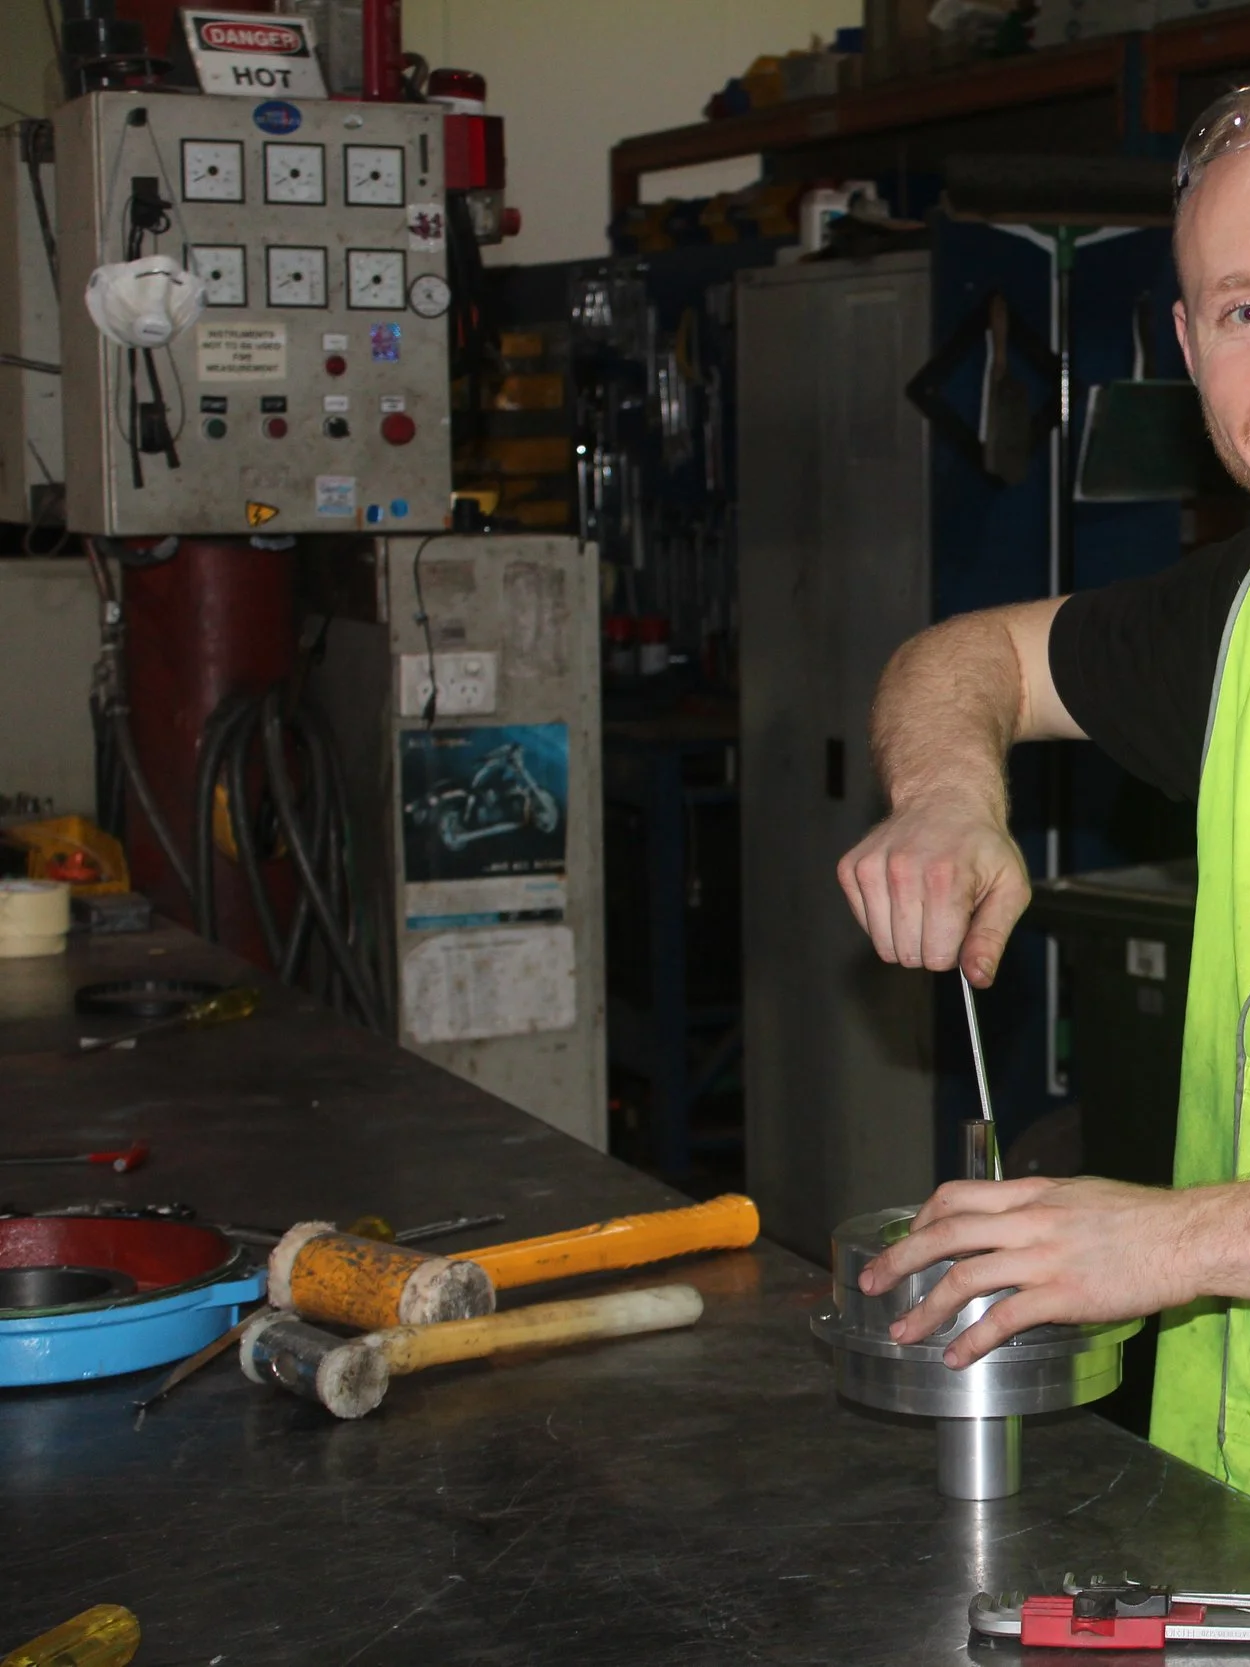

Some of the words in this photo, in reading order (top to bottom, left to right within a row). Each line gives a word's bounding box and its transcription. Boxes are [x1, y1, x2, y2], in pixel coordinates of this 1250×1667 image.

[210, 28, 296, 48] DANGER
[232, 66, 292, 89] HOT
[208, 330, 275, 338] INSTRUMENTS
[206, 364, 280, 372] MEASUREMENT
